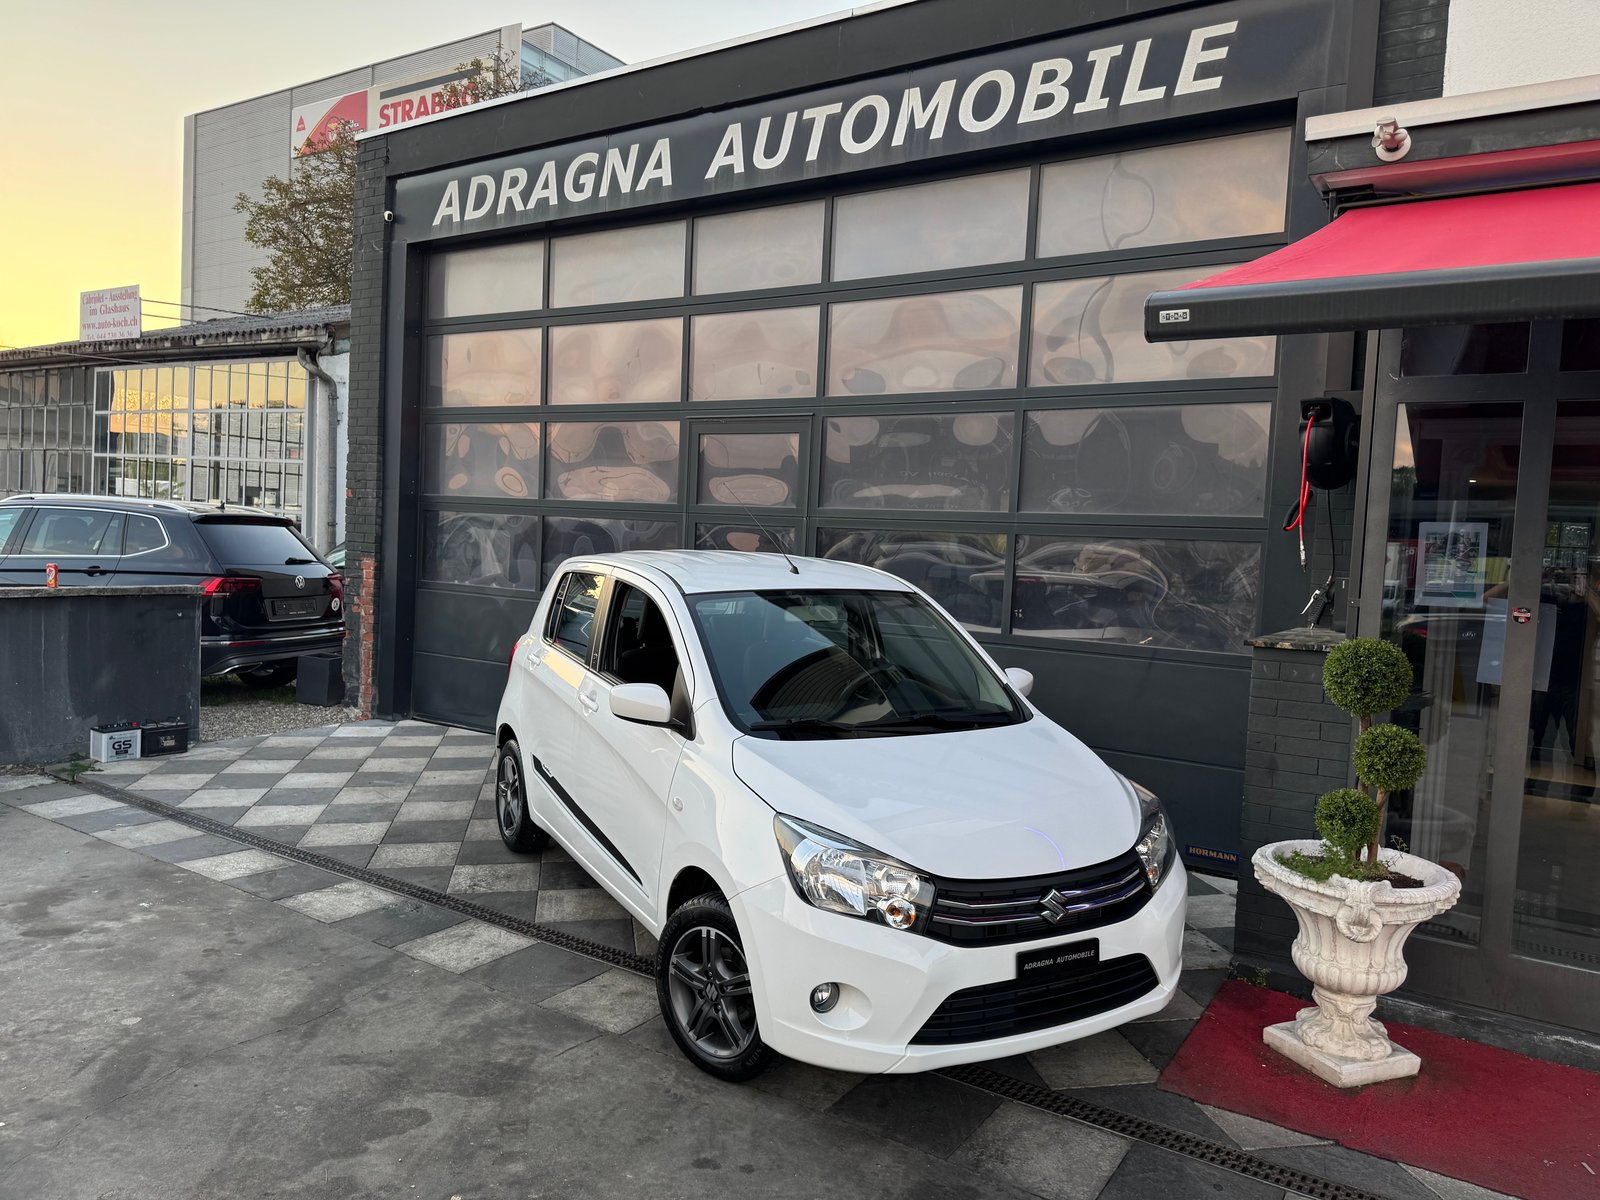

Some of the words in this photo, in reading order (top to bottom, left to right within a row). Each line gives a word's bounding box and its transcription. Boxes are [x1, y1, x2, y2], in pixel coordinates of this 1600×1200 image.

[432, 137, 673, 226] ADRAGNA
[704, 20, 1238, 180] AUTOMOBILE
[89, 305, 98, 316] im
[99, 303, 130, 315] Glashaus
[1161, 311, 1188, 322] STOBAG
[82, 315, 138, 331] www.auto-koch.ch
[112, 739, 132, 751] GS
[1023, 958, 1054, 971] ADRAGNA
[1056, 949, 1095, 964] AUTOMOBILE
